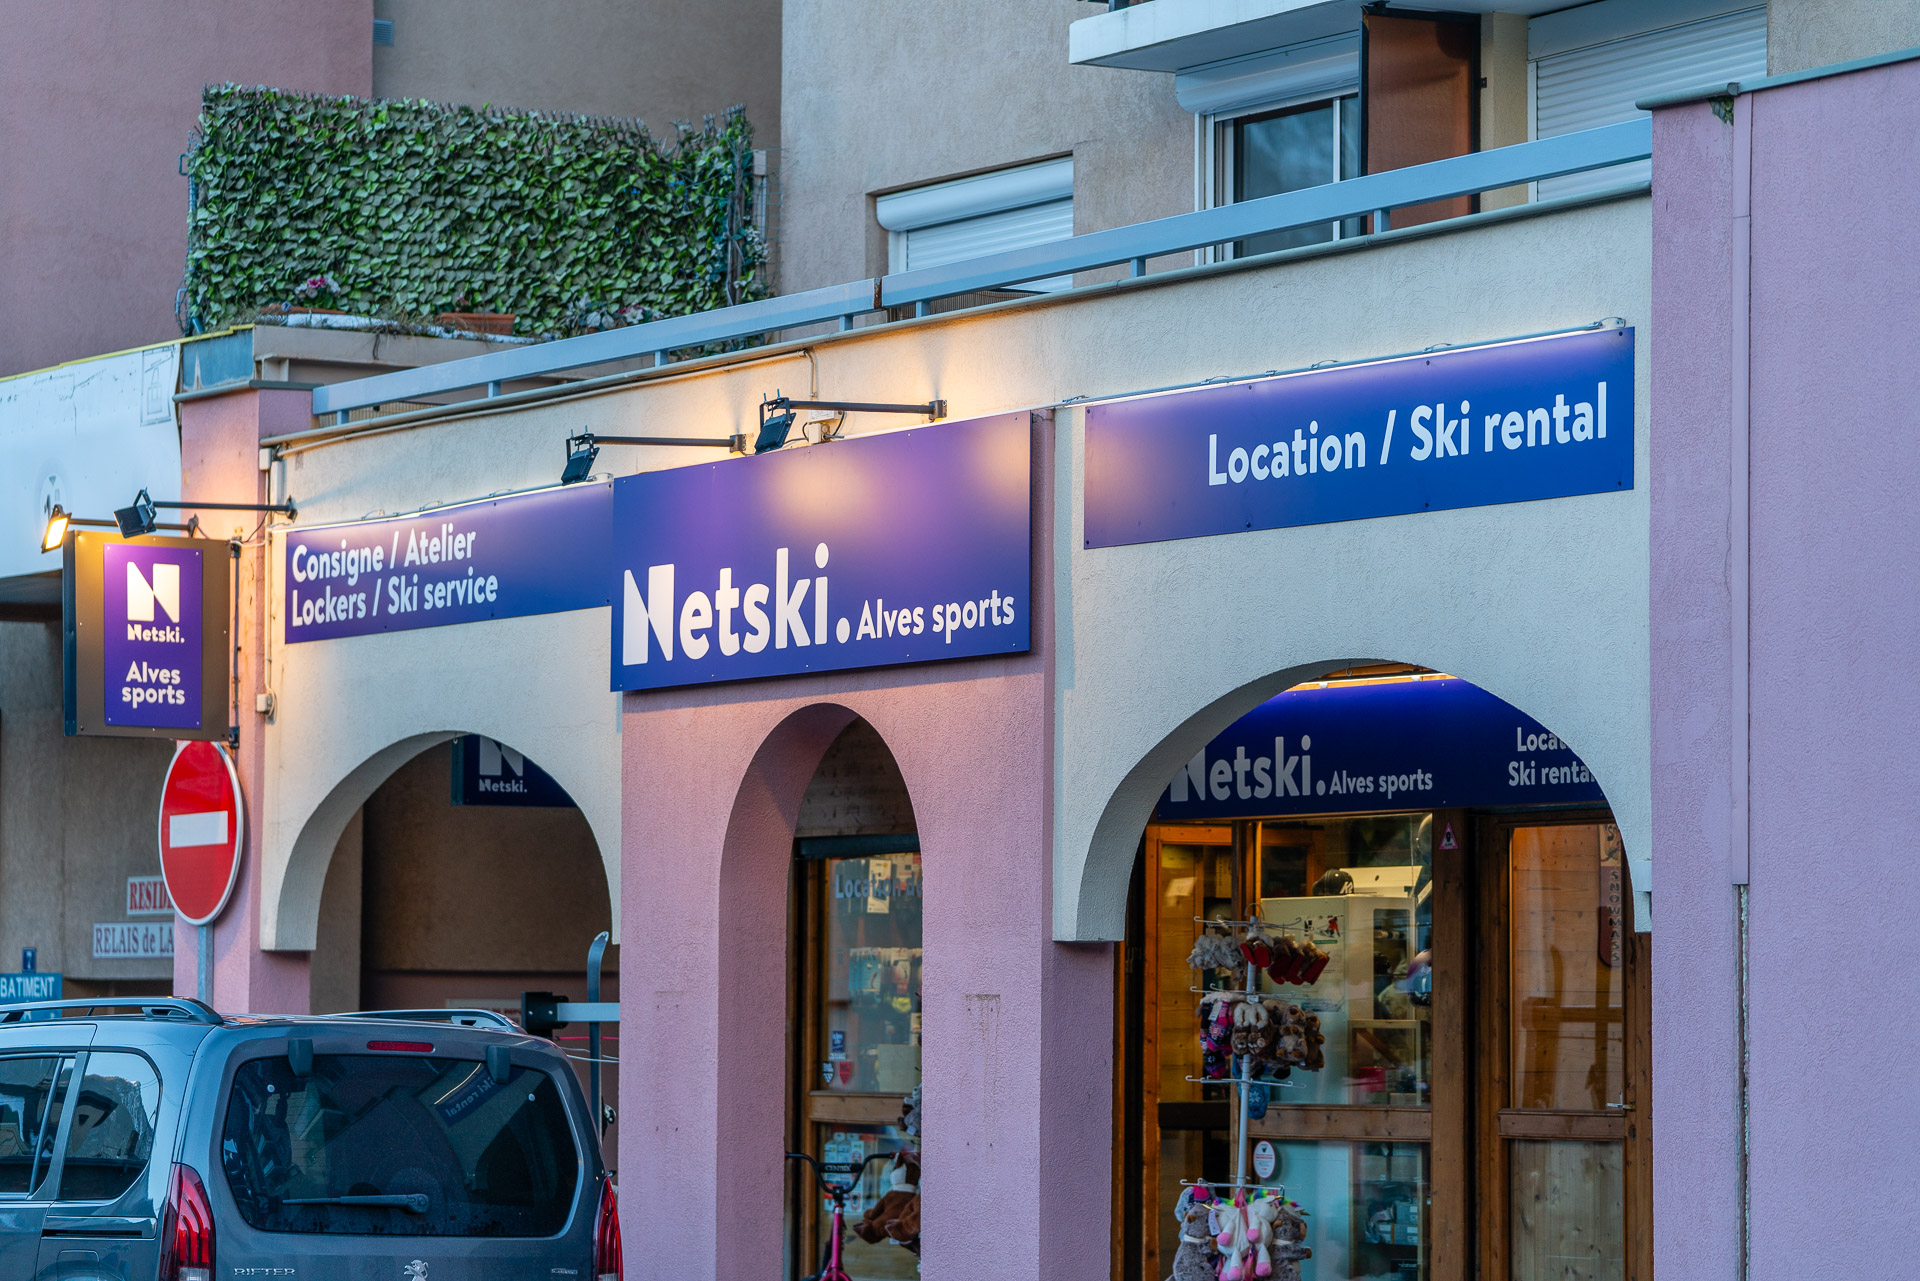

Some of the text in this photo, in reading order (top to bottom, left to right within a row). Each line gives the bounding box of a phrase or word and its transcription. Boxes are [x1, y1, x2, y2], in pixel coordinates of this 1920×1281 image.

[1208, 381, 1608, 486] Location / Ski rental
[292, 522, 477, 586] Consigne / Atelier
[127, 561, 180, 623] N
[292, 566, 498, 627] Lockers / Ski service
[622, 542, 1015, 666] Netski. Alves sports
[127, 623, 185, 643] Netski.
[125, 660, 181, 685] Alves
[121, 685, 186, 709] sports
[1517, 727, 1570, 752] Loca
[479, 778, 528, 793] Netski.
[1329, 770, 1374, 795] Alves
[1378, 768, 1433, 799] sports
[1508, 760, 1596, 786] Ski renta
[129, 881, 174, 911] RESID
[835, 871, 901, 899] Location
[95, 926, 174, 954] RELAIS de LA
[0, 976, 55, 998] BATIMENT
[234, 1268, 295, 1276] RIFTER
